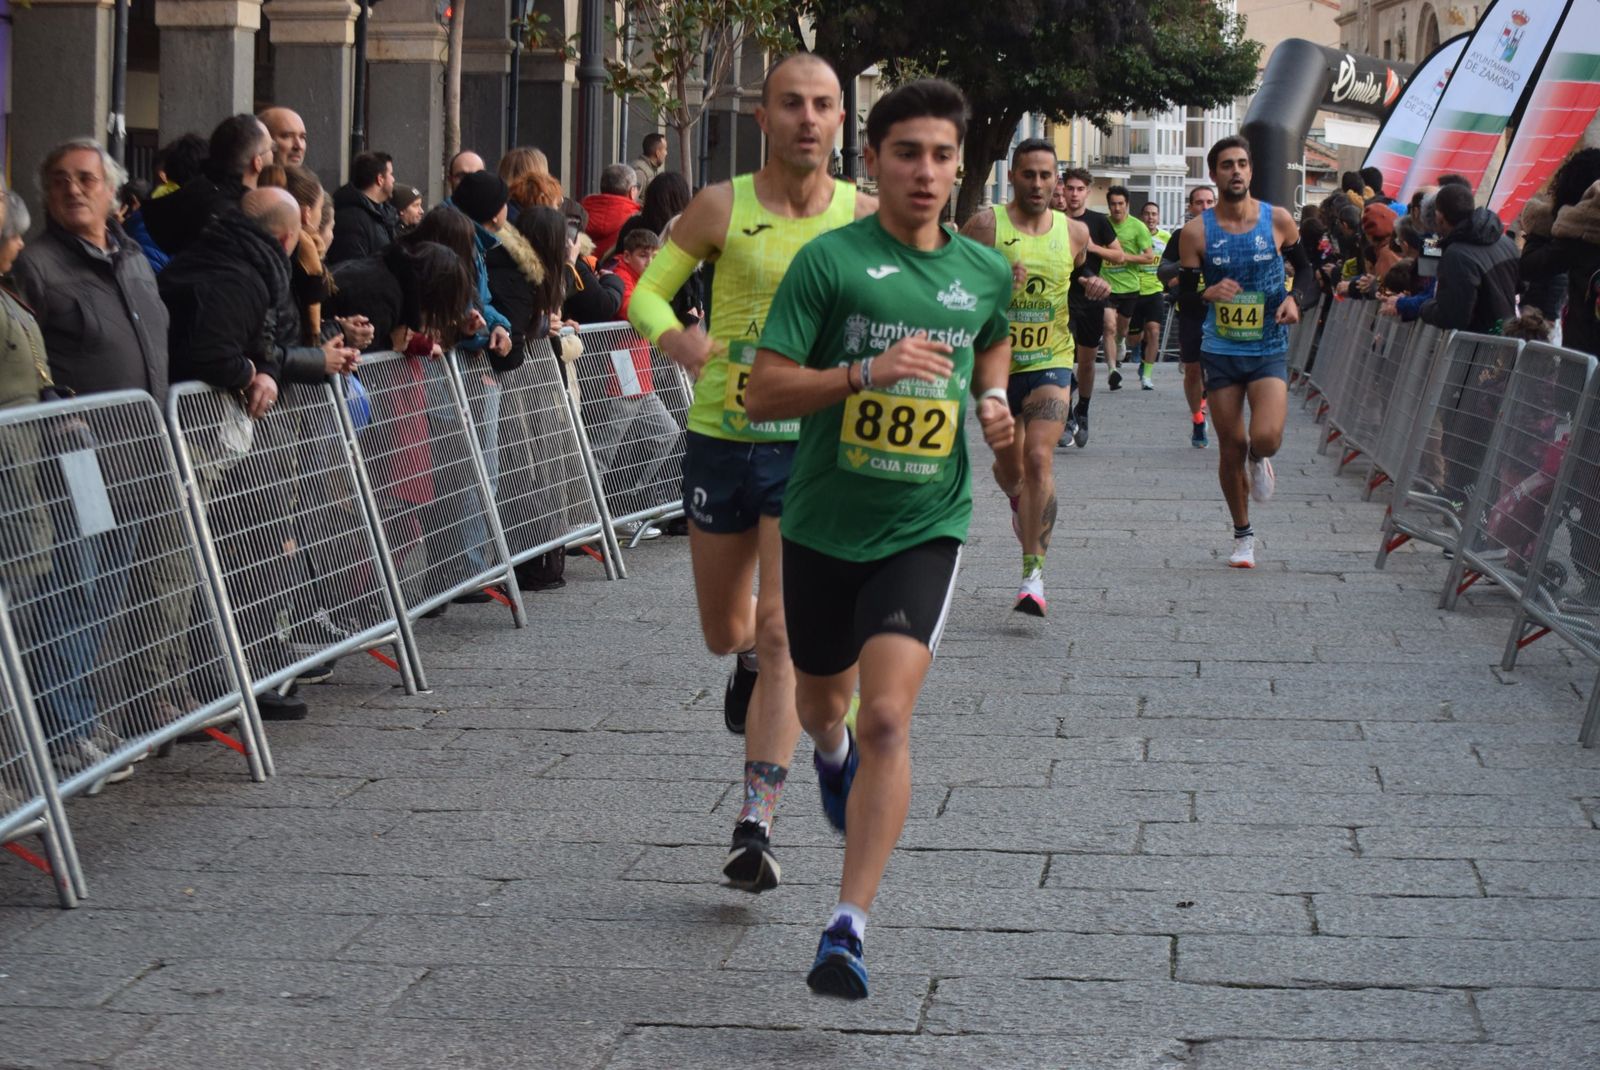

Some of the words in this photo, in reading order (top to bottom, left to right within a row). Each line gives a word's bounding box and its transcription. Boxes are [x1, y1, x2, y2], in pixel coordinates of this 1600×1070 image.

[1464, 60, 1478, 74] DE
[1478, 67, 1515, 92] ZAMORA
[1470, 51, 1521, 82] AYUNTAMIENTO
[1220, 307, 1258, 327] 844
[914, 387, 948, 399] RURAL
[855, 399, 946, 449] 882
[870, 457, 901, 472] CAJA
